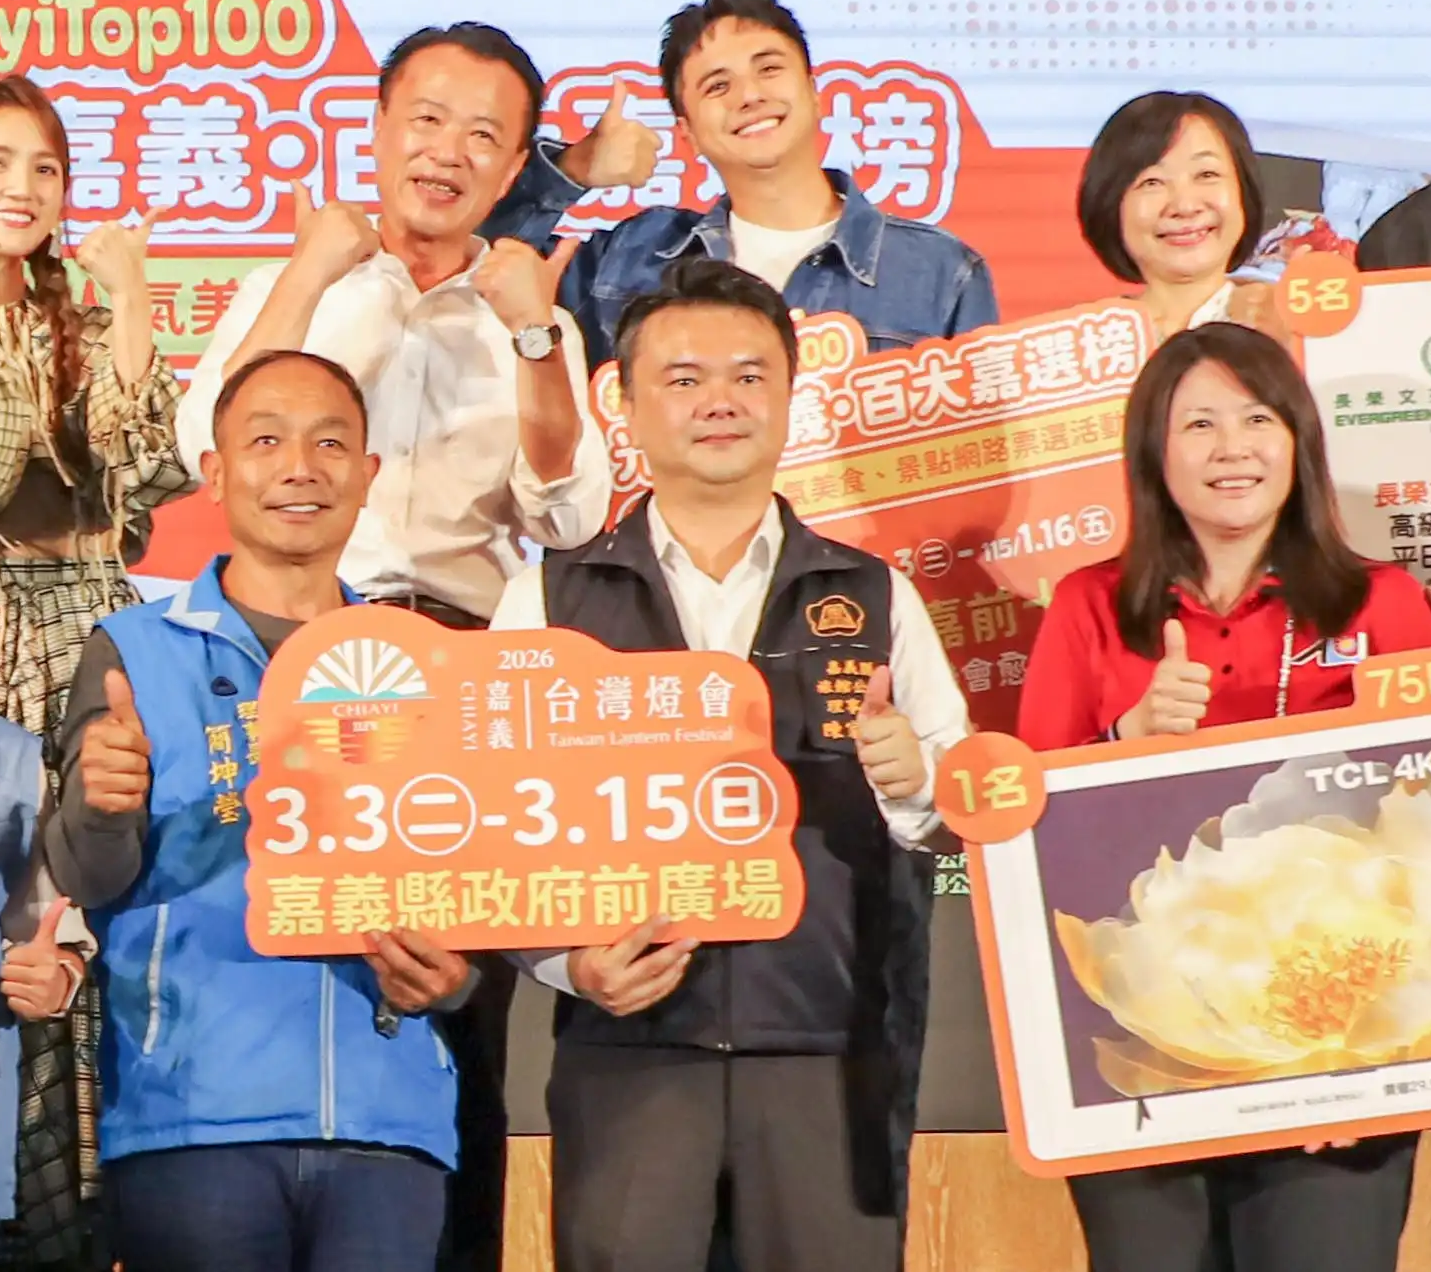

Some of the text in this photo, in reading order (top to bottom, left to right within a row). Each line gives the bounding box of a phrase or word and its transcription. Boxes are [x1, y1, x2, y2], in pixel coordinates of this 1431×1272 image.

[1286, 276, 1351, 315] 5名
[497, 648, 556, 671] 2026
[331, 702, 400, 718] CHIAYI
[459, 681, 479, 751] CHIAYI
[485, 679, 515, 750] 嘉義
[543, 670, 737, 724] 台灣燈會
[546, 725, 735, 748] Taiwan Lantern Festival
[950, 764, 1029, 814] 1名
[1304, 760, 1389, 793] TCL
[266, 858, 784, 938] 嘉義縣政府前廣場
